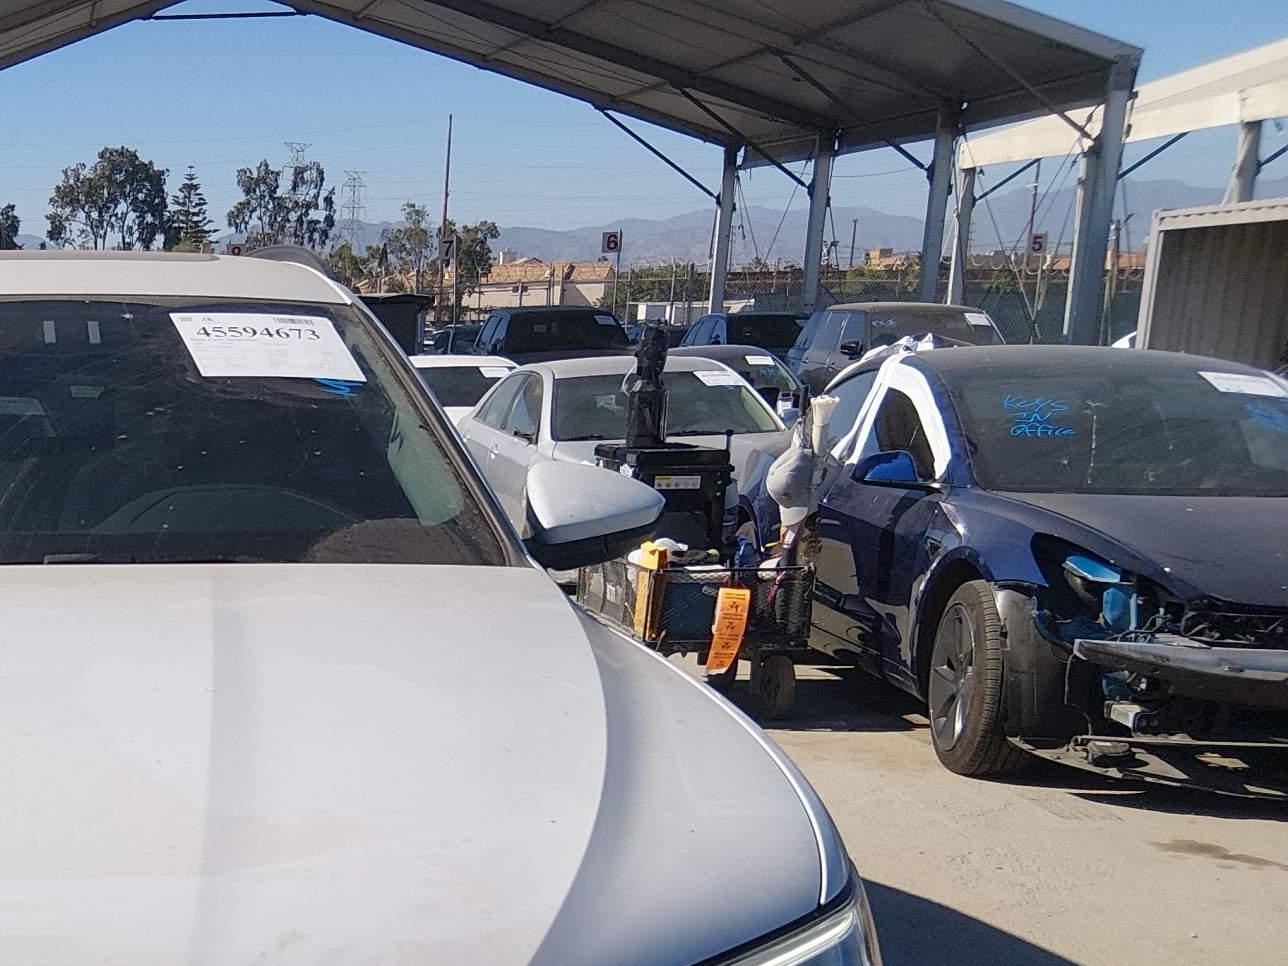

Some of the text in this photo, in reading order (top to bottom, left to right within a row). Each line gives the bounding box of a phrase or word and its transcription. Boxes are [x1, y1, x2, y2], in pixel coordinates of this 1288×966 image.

[442, 240, 454, 257] 7
[607, 234, 618, 251] 6
[1031, 235, 1043, 252] 5
[196, 326, 320, 341] 45594673
